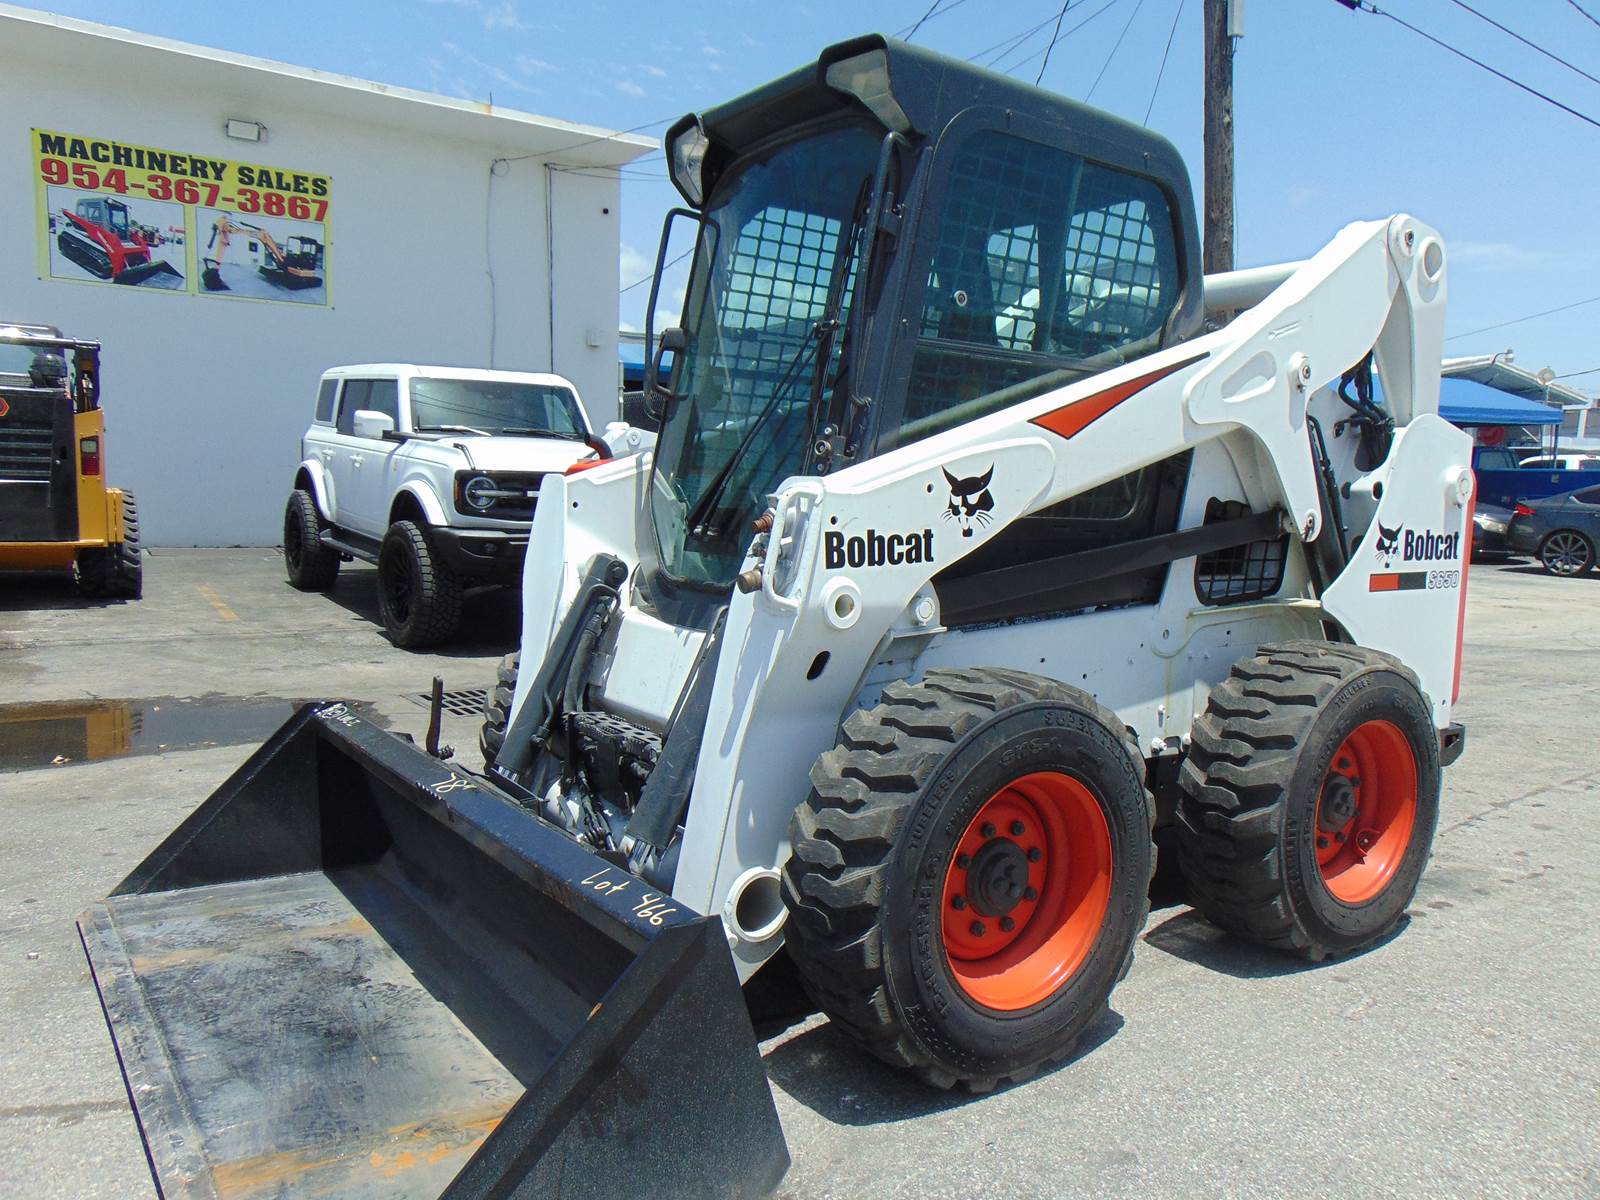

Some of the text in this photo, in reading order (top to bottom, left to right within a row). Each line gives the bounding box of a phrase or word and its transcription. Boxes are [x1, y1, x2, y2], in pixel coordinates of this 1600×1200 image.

[39, 133, 328, 196] MACHINERY SALES
[40, 158, 329, 222] 954-367-3867
[824, 528, 934, 570] Bobcat
[1403, 529, 1460, 561] Bobcat
[1427, 570, 1460, 589] S650
[580, 867, 677, 926] Lot 466
